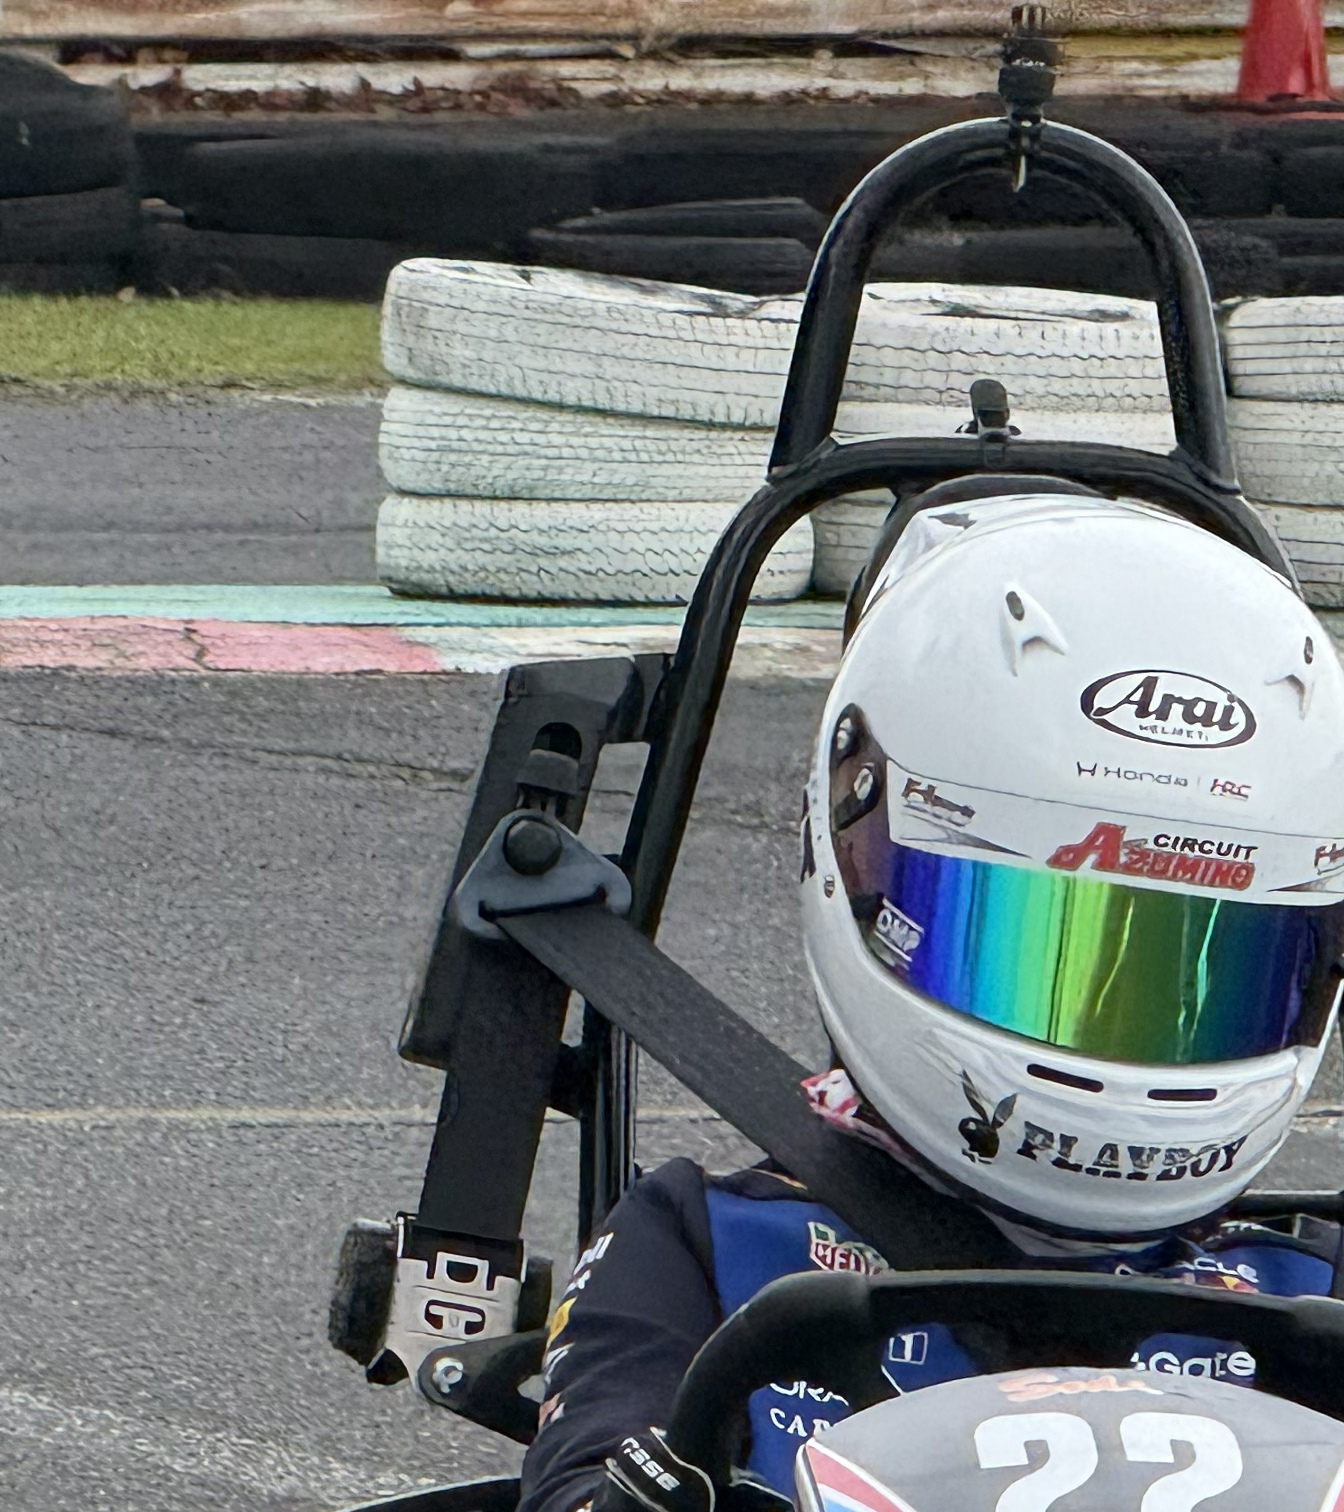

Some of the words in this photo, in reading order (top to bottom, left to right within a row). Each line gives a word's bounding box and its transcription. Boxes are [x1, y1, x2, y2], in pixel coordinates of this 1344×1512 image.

[1092, 675, 1239, 732] Arai
[1153, 833, 1259, 860] CIRCUIT
[1016, 1120, 1249, 1182] PLAYBOY
